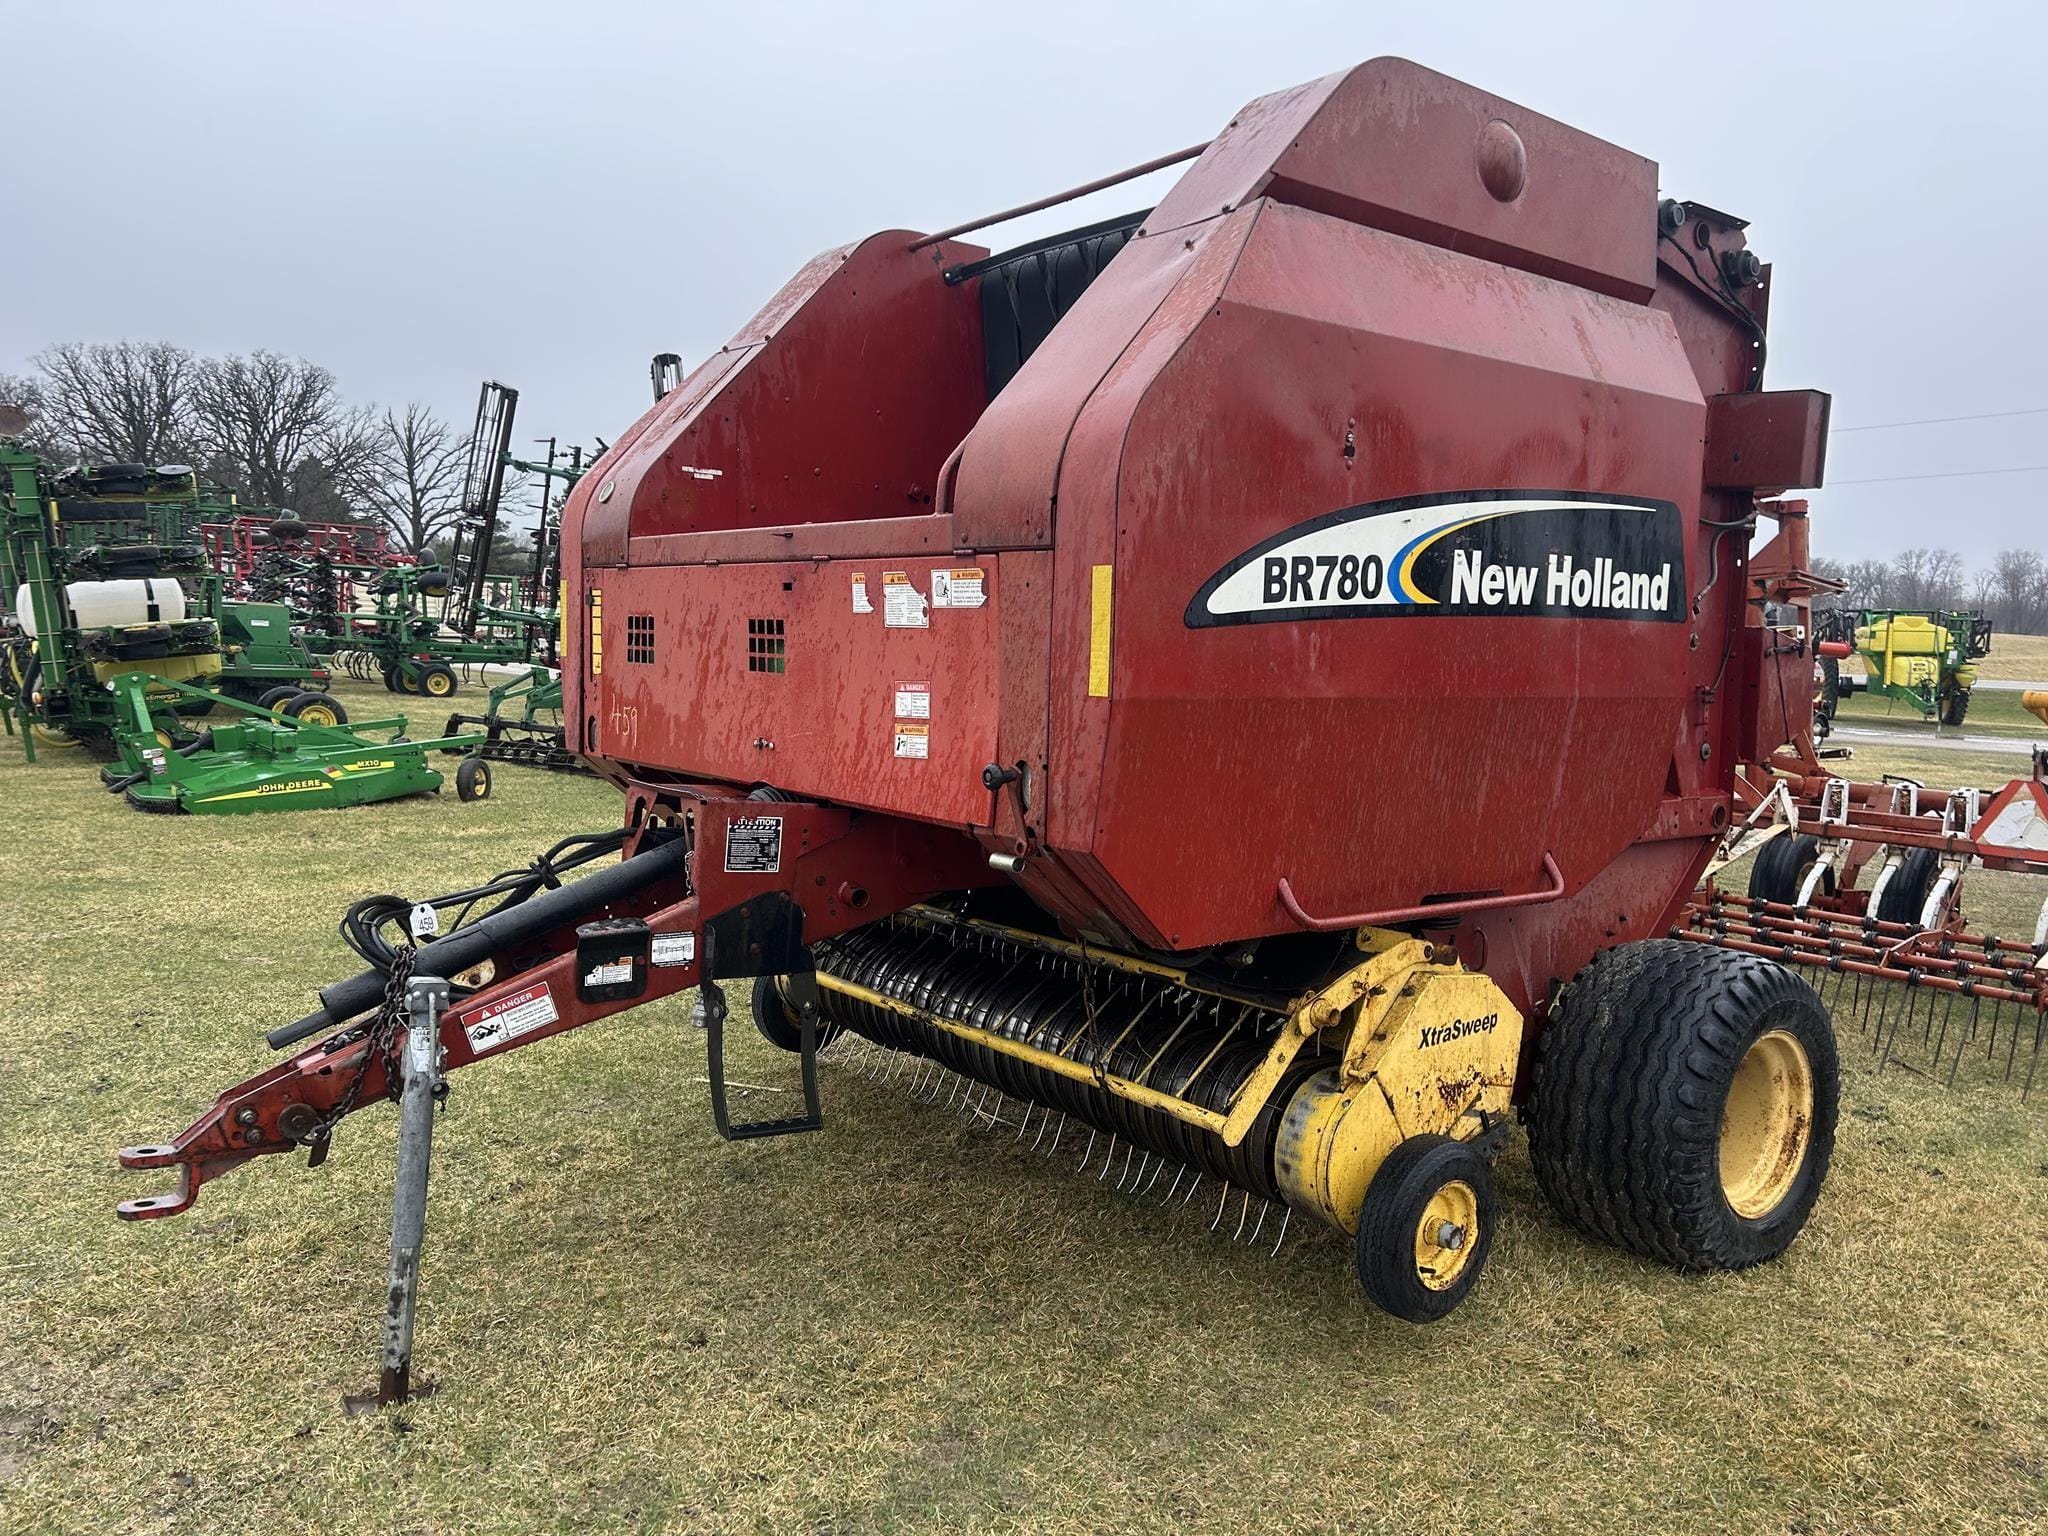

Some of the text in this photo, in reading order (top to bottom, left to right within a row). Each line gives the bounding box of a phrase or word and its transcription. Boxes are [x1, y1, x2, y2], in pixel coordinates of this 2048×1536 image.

[1263, 554, 1384, 604] BR780
[1450, 548, 1671, 612] New Holland
[611, 692, 638, 748] 459
[356, 759, 380, 768] MX10
[256, 779, 322, 794] JOHN DEERE
[419, 916, 434, 932] 459
[495, 992, 533, 1013] DANGER
[1417, 1012, 1498, 1050] XtraSweep
